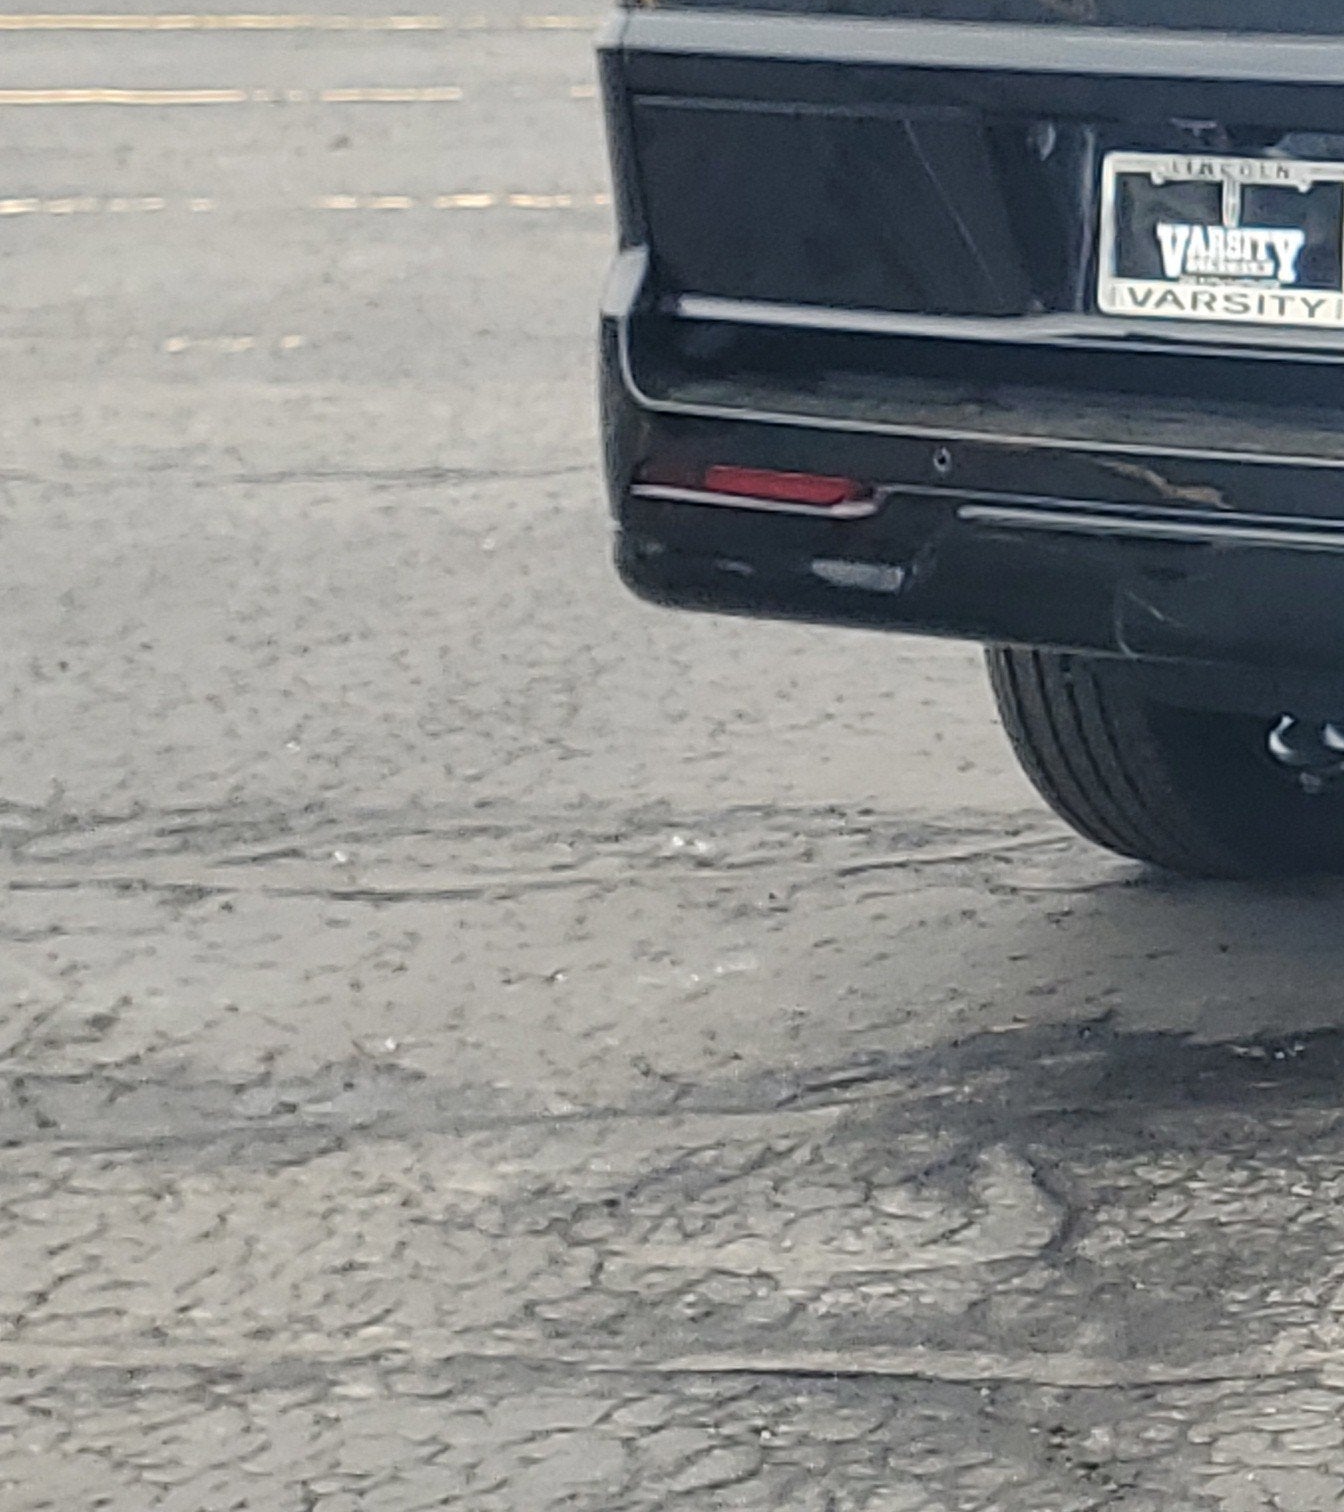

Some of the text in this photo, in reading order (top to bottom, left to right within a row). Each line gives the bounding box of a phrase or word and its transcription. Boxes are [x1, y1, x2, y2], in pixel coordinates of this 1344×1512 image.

[1171, 158, 1291, 180] LINCOLN
[1156, 222, 1305, 283] VARSITY
[1127, 286, 1330, 320] VARSITY
